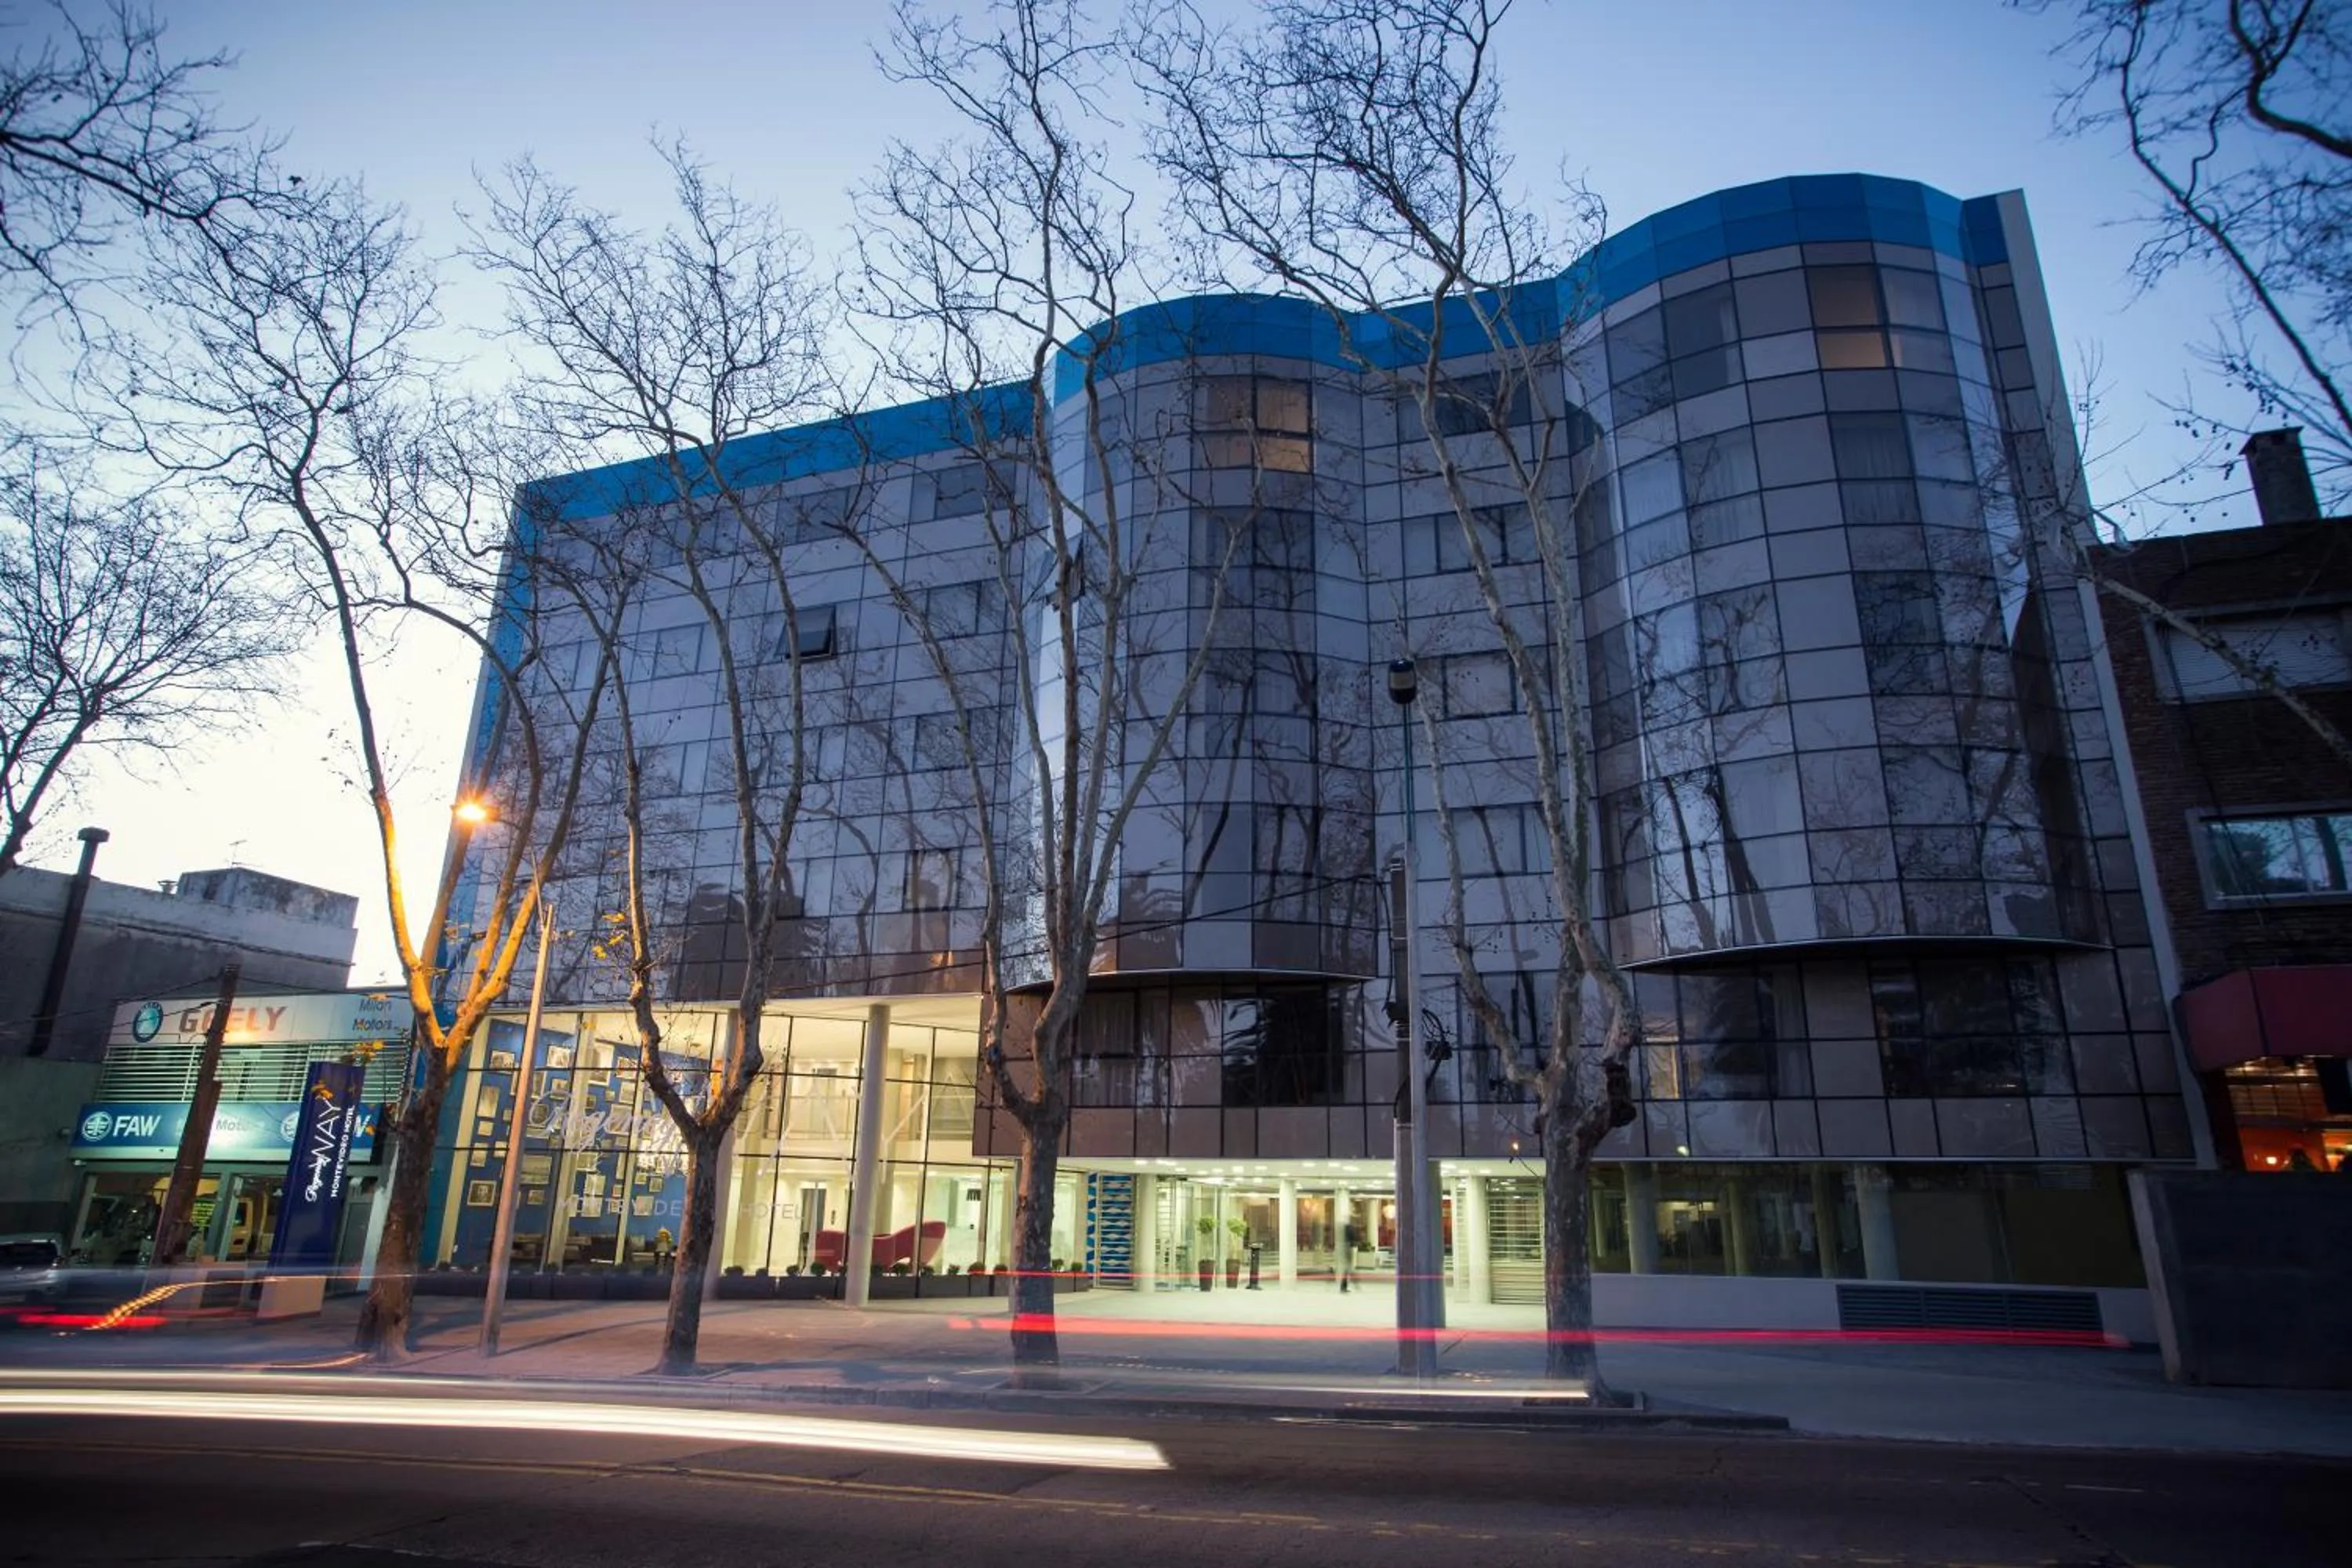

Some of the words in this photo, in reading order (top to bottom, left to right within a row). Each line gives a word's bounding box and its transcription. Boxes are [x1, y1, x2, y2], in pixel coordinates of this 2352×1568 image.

[112, 1115, 162, 1137] FAW
[331, 1134, 349, 1198] MONTEVIDEO
[343, 1105, 355, 1132] HOTEL
